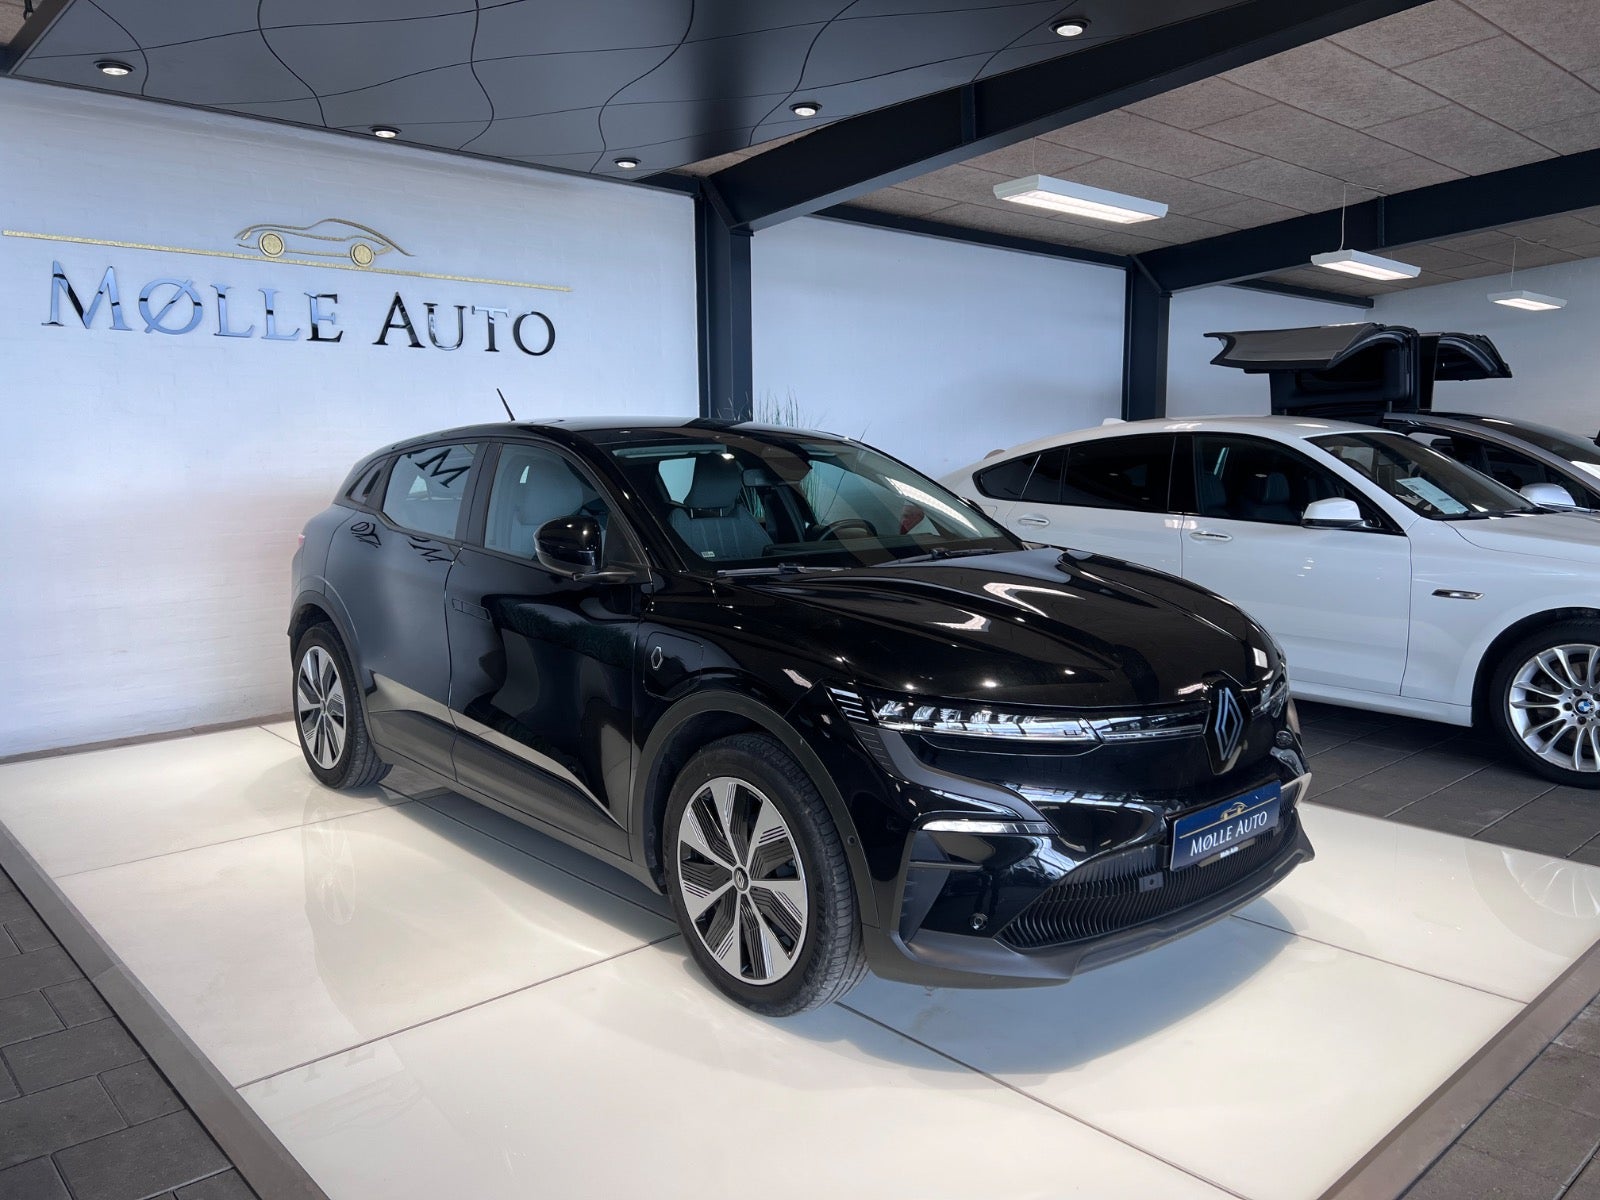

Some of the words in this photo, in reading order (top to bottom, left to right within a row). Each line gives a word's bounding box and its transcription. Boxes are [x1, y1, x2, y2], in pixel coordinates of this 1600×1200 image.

[41, 260, 343, 342] MØLLE
[372, 291, 556, 356] AUTO
[1190, 826, 1233, 856] MØLLE
[1236, 811, 1268, 836] AUTO
